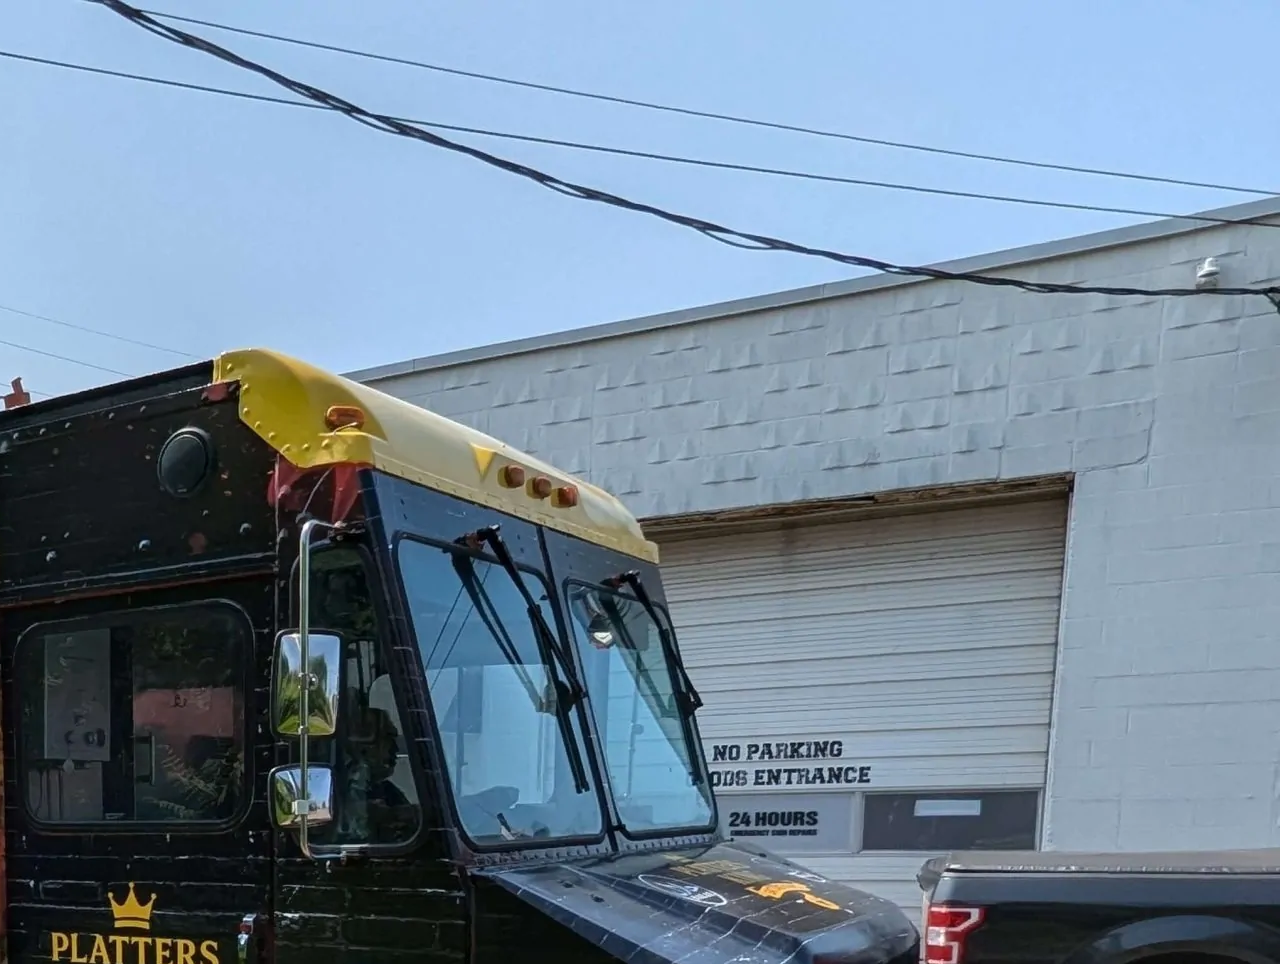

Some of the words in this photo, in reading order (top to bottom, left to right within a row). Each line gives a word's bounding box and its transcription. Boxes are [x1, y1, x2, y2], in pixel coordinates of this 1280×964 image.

[712, 744, 741, 762] NO
[745, 740, 843, 761] PARKING
[709, 769, 748, 787] ODS
[753, 766, 872, 786] ENTRANCE
[728, 811, 751, 827] 24
[755, 811, 819, 827] HOURS
